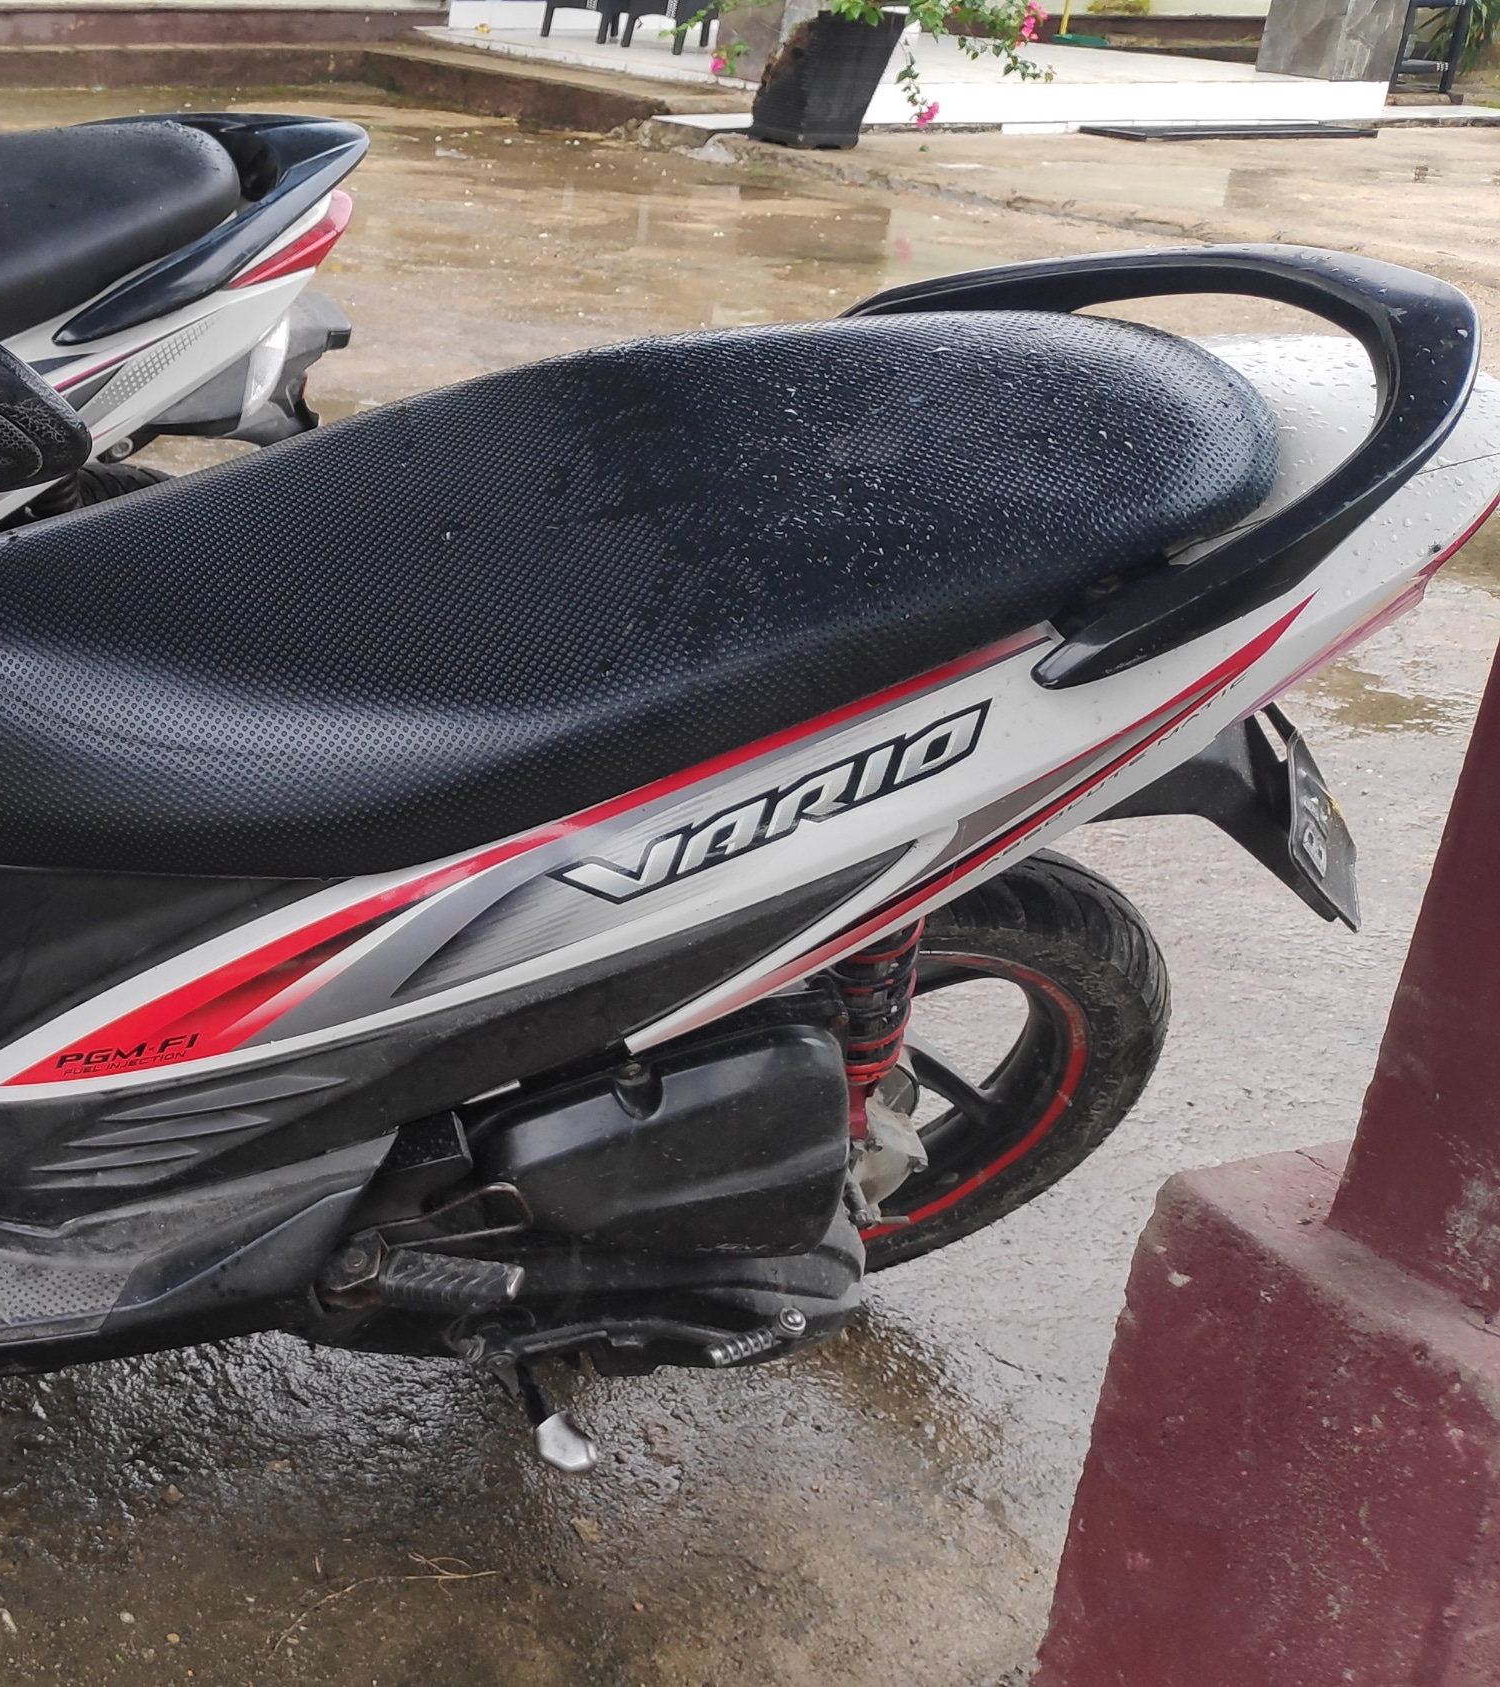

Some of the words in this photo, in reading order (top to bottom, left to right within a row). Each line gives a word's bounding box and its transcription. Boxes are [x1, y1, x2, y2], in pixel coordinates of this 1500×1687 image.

[547, 698, 993, 904] VARIO
[980, 751, 1147, 872] ABSOLUTE
[1157, 672, 1247, 747] MATIC
[56, 1032, 200, 1069] PGM-FI
[63, 1064, 101, 1077] FUEL
[106, 1050, 187, 1071] INJECTION
